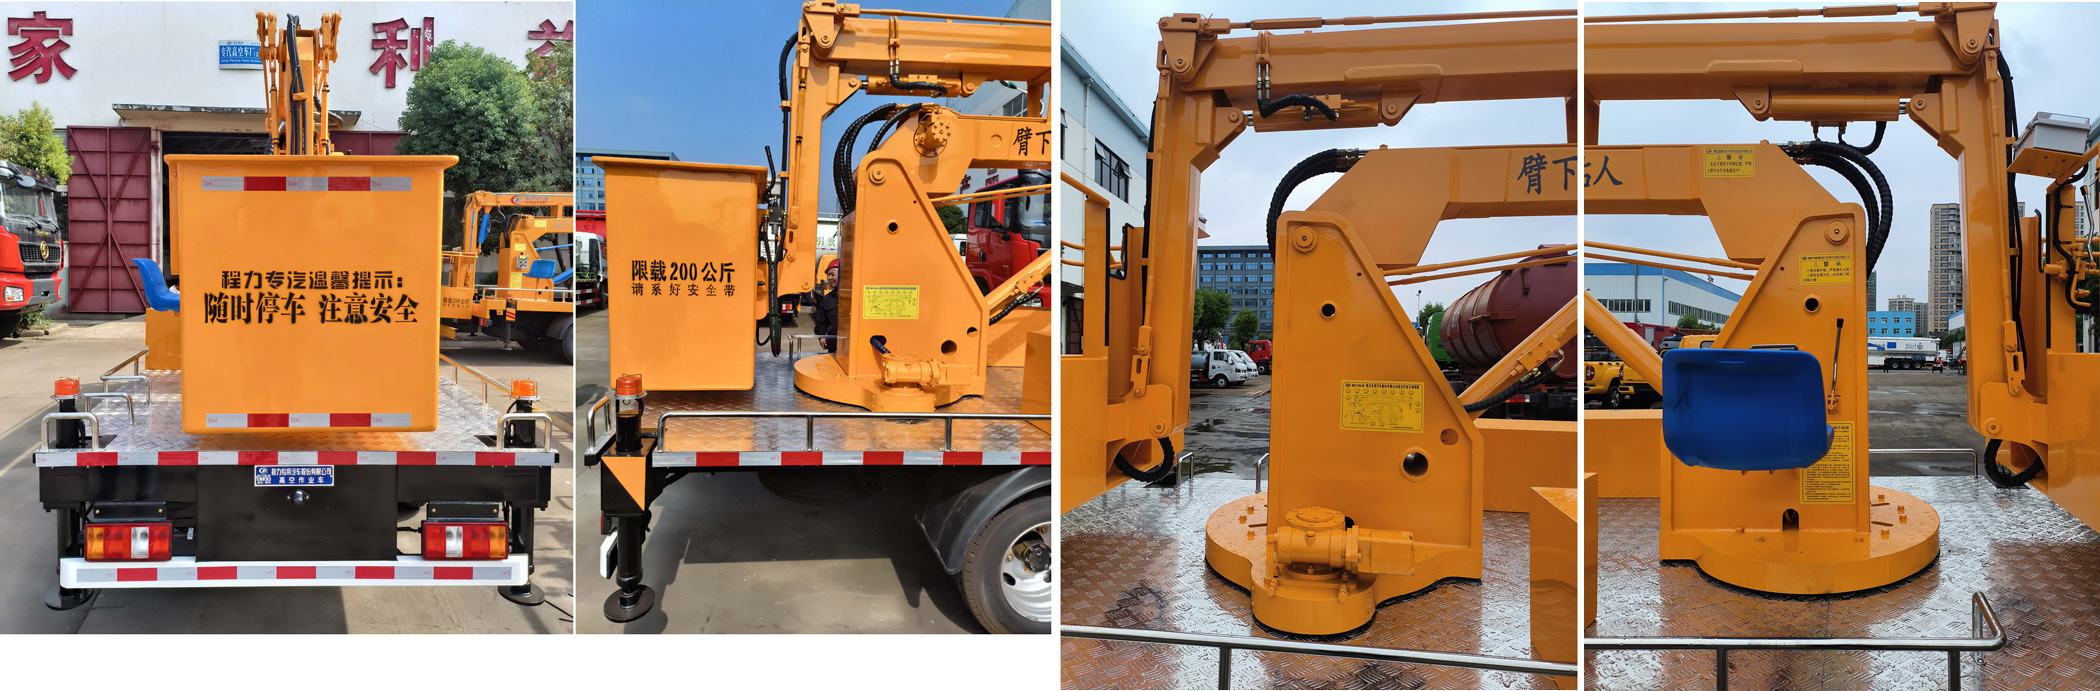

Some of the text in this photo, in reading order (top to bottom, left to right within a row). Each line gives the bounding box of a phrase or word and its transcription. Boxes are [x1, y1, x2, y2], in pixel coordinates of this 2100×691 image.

[8, 11, 435, 89] 家 利
[1013, 126, 1052, 157] 臂下
[1517, 153, 1578, 195] 臂下
[631, 260, 735, 283] 限载200公斤
[631, 282, 735, 297] 请系好安全带
[204, 291, 419, 324] 随时停车 注意安全
